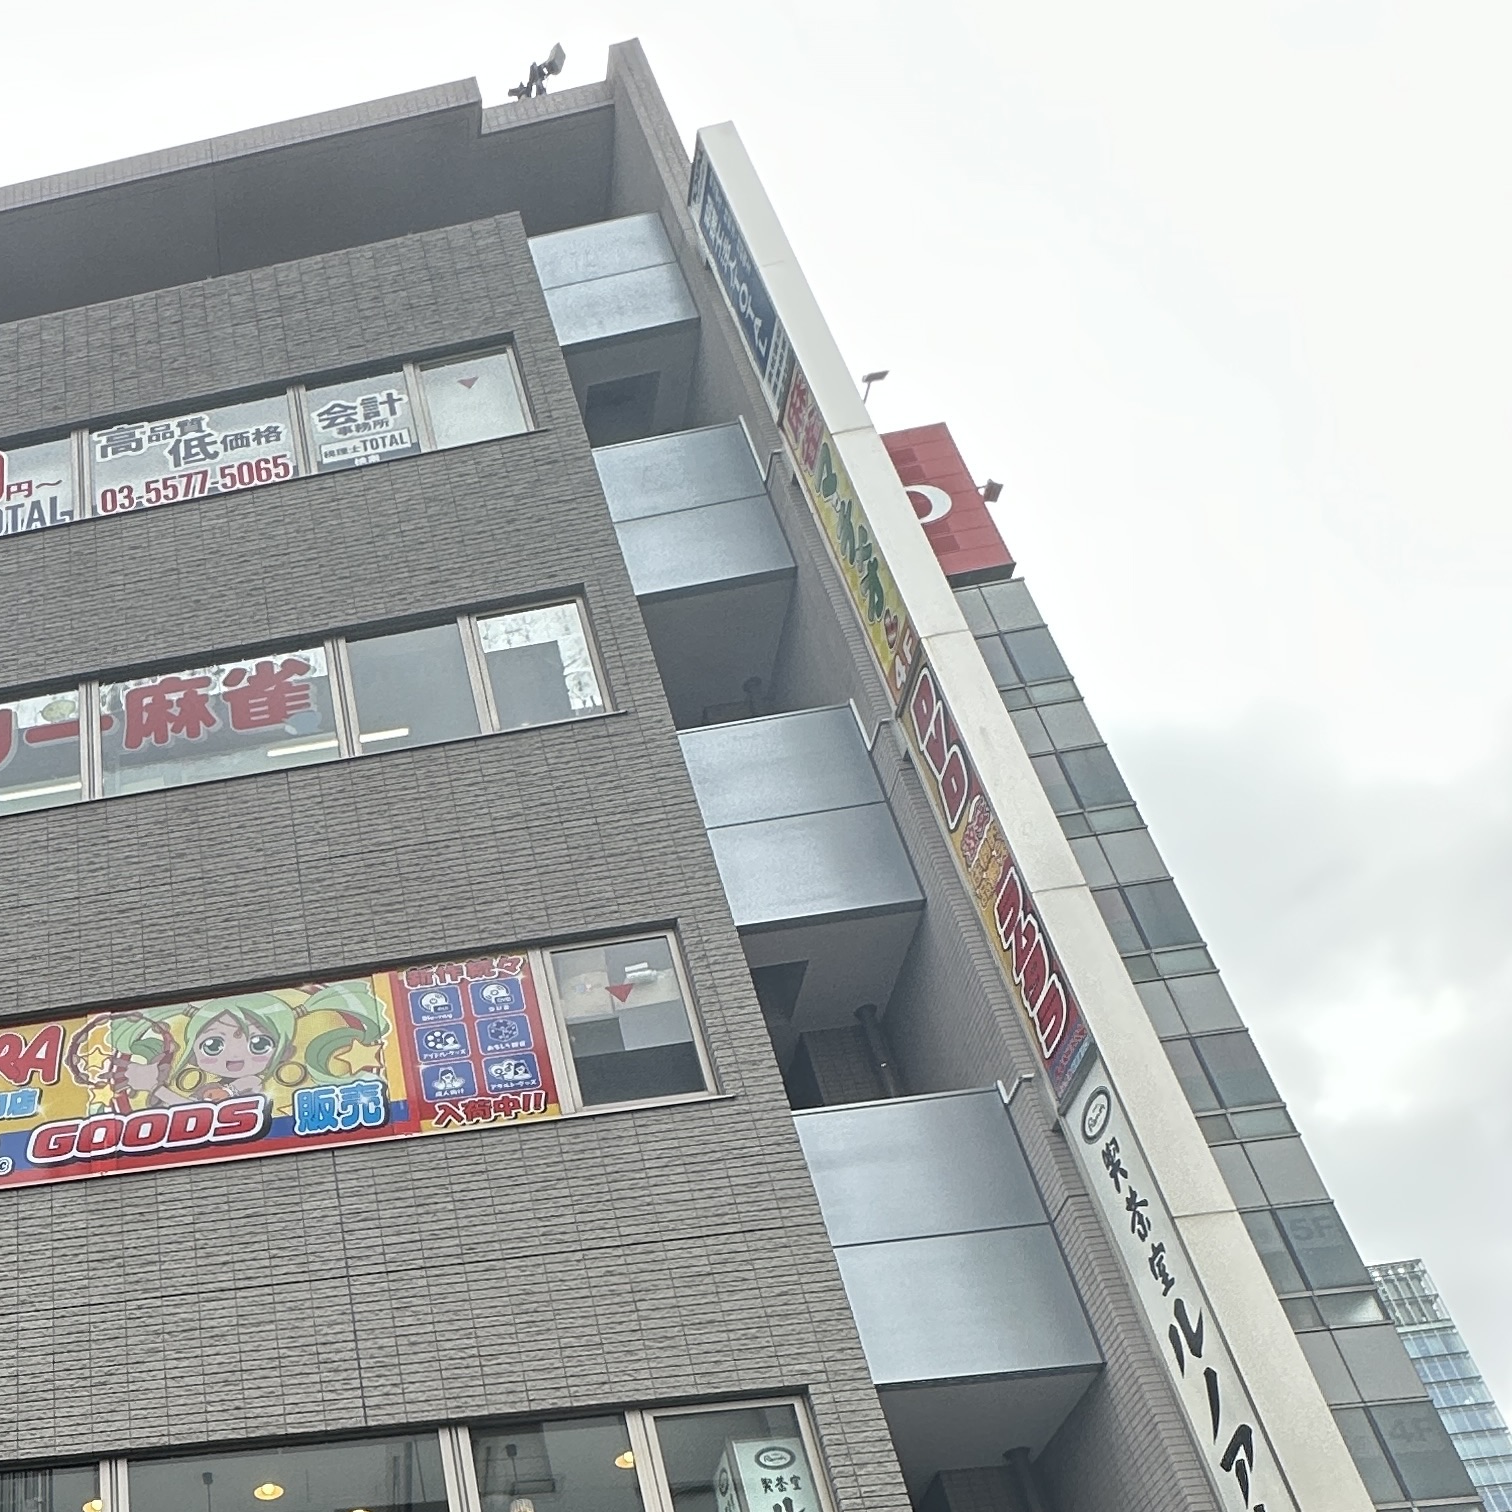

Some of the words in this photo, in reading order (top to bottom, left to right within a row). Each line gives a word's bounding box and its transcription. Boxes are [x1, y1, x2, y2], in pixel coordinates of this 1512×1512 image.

[317, 391, 406, 430] 会計
[336, 419, 390, 436] 事務所
[99, 415, 206, 458] 高品質
[168, 425, 282, 467] 低価格
[100, 454, 290, 513] 03-5577-5065
[910, 667, 969, 832] DVD
[295, 1081, 383, 1133] 販売
[29, 1098, 263, 1163] GOODS
[760, 1475, 802, 1494] 喫茶室
